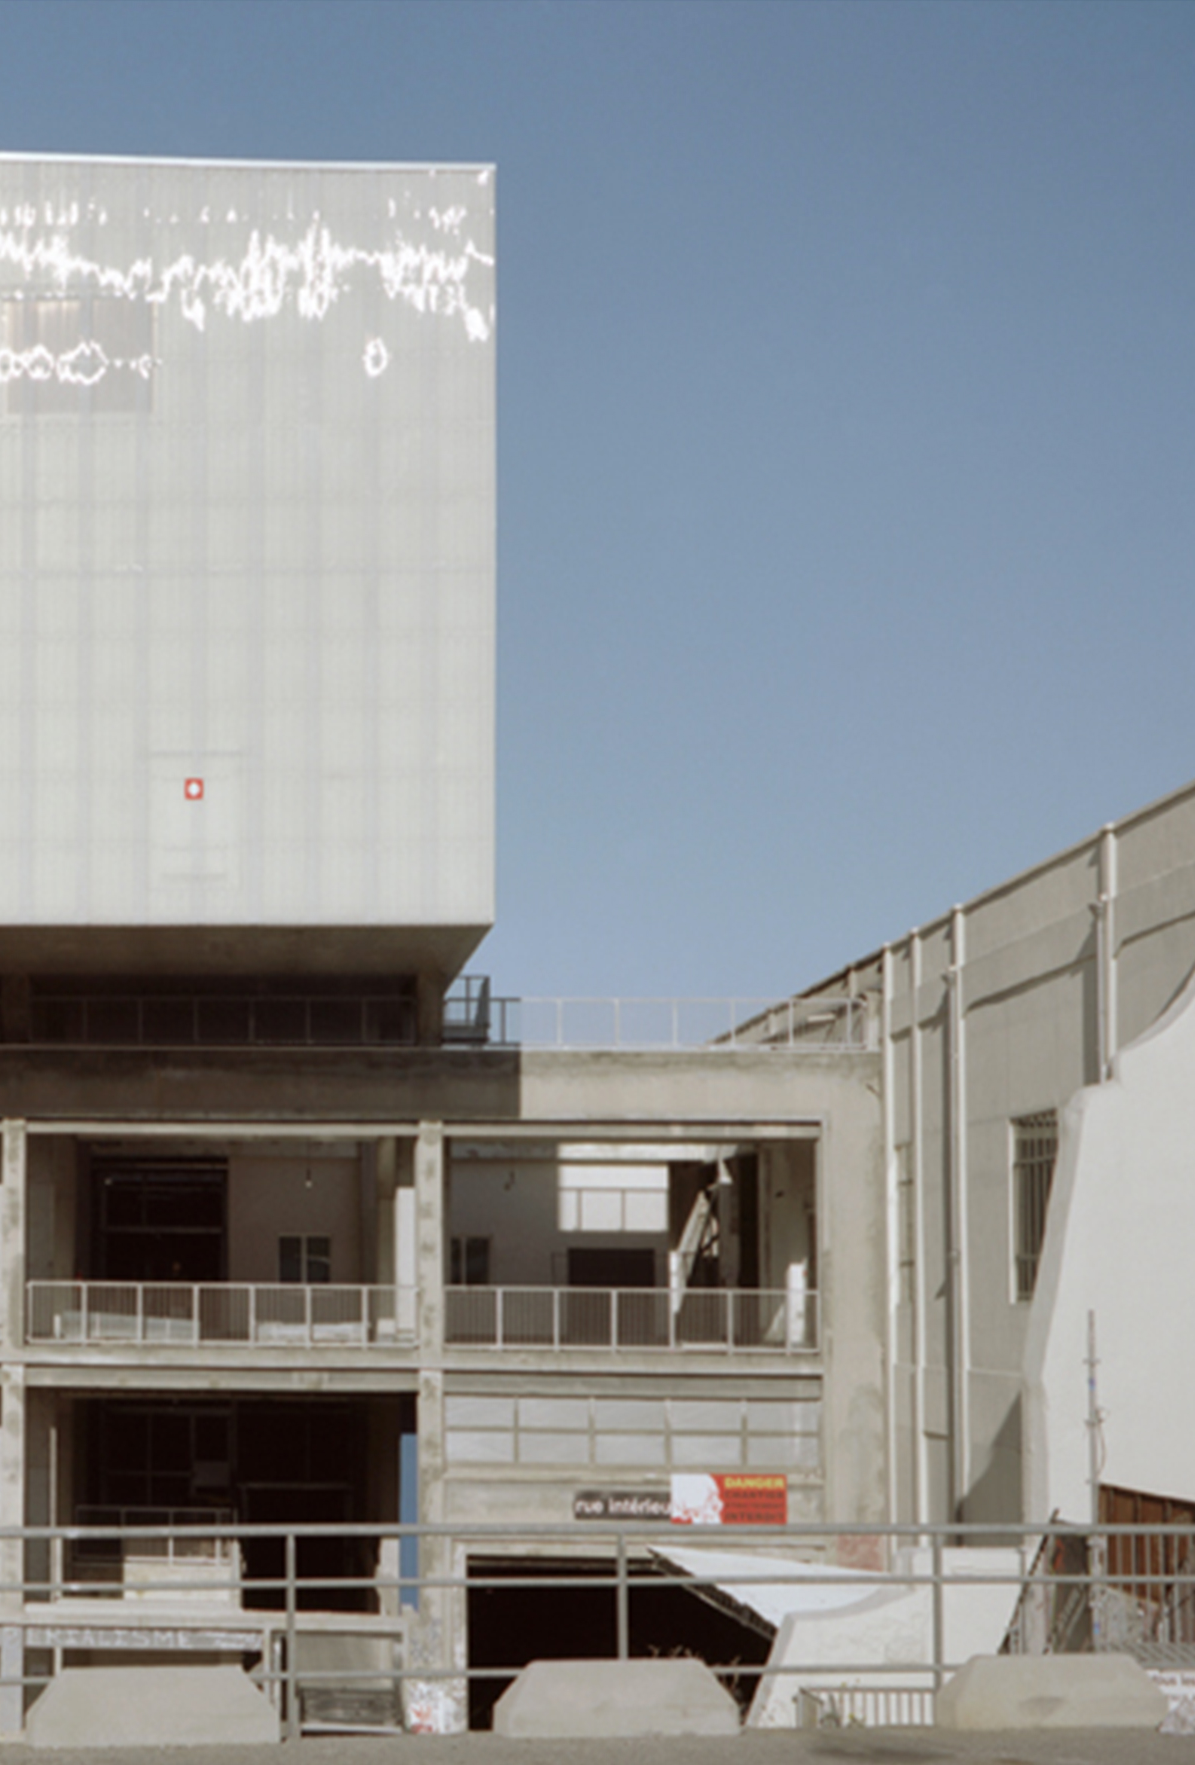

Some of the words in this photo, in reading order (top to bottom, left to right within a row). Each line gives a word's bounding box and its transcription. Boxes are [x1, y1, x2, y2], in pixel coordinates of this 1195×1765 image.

[724, 1476, 784, 1489] DANGER
[724, 1490, 784, 1499] CHANTIER
[574, 1500, 604, 1514] rue
[608, 1497, 673, 1515] intérieu
